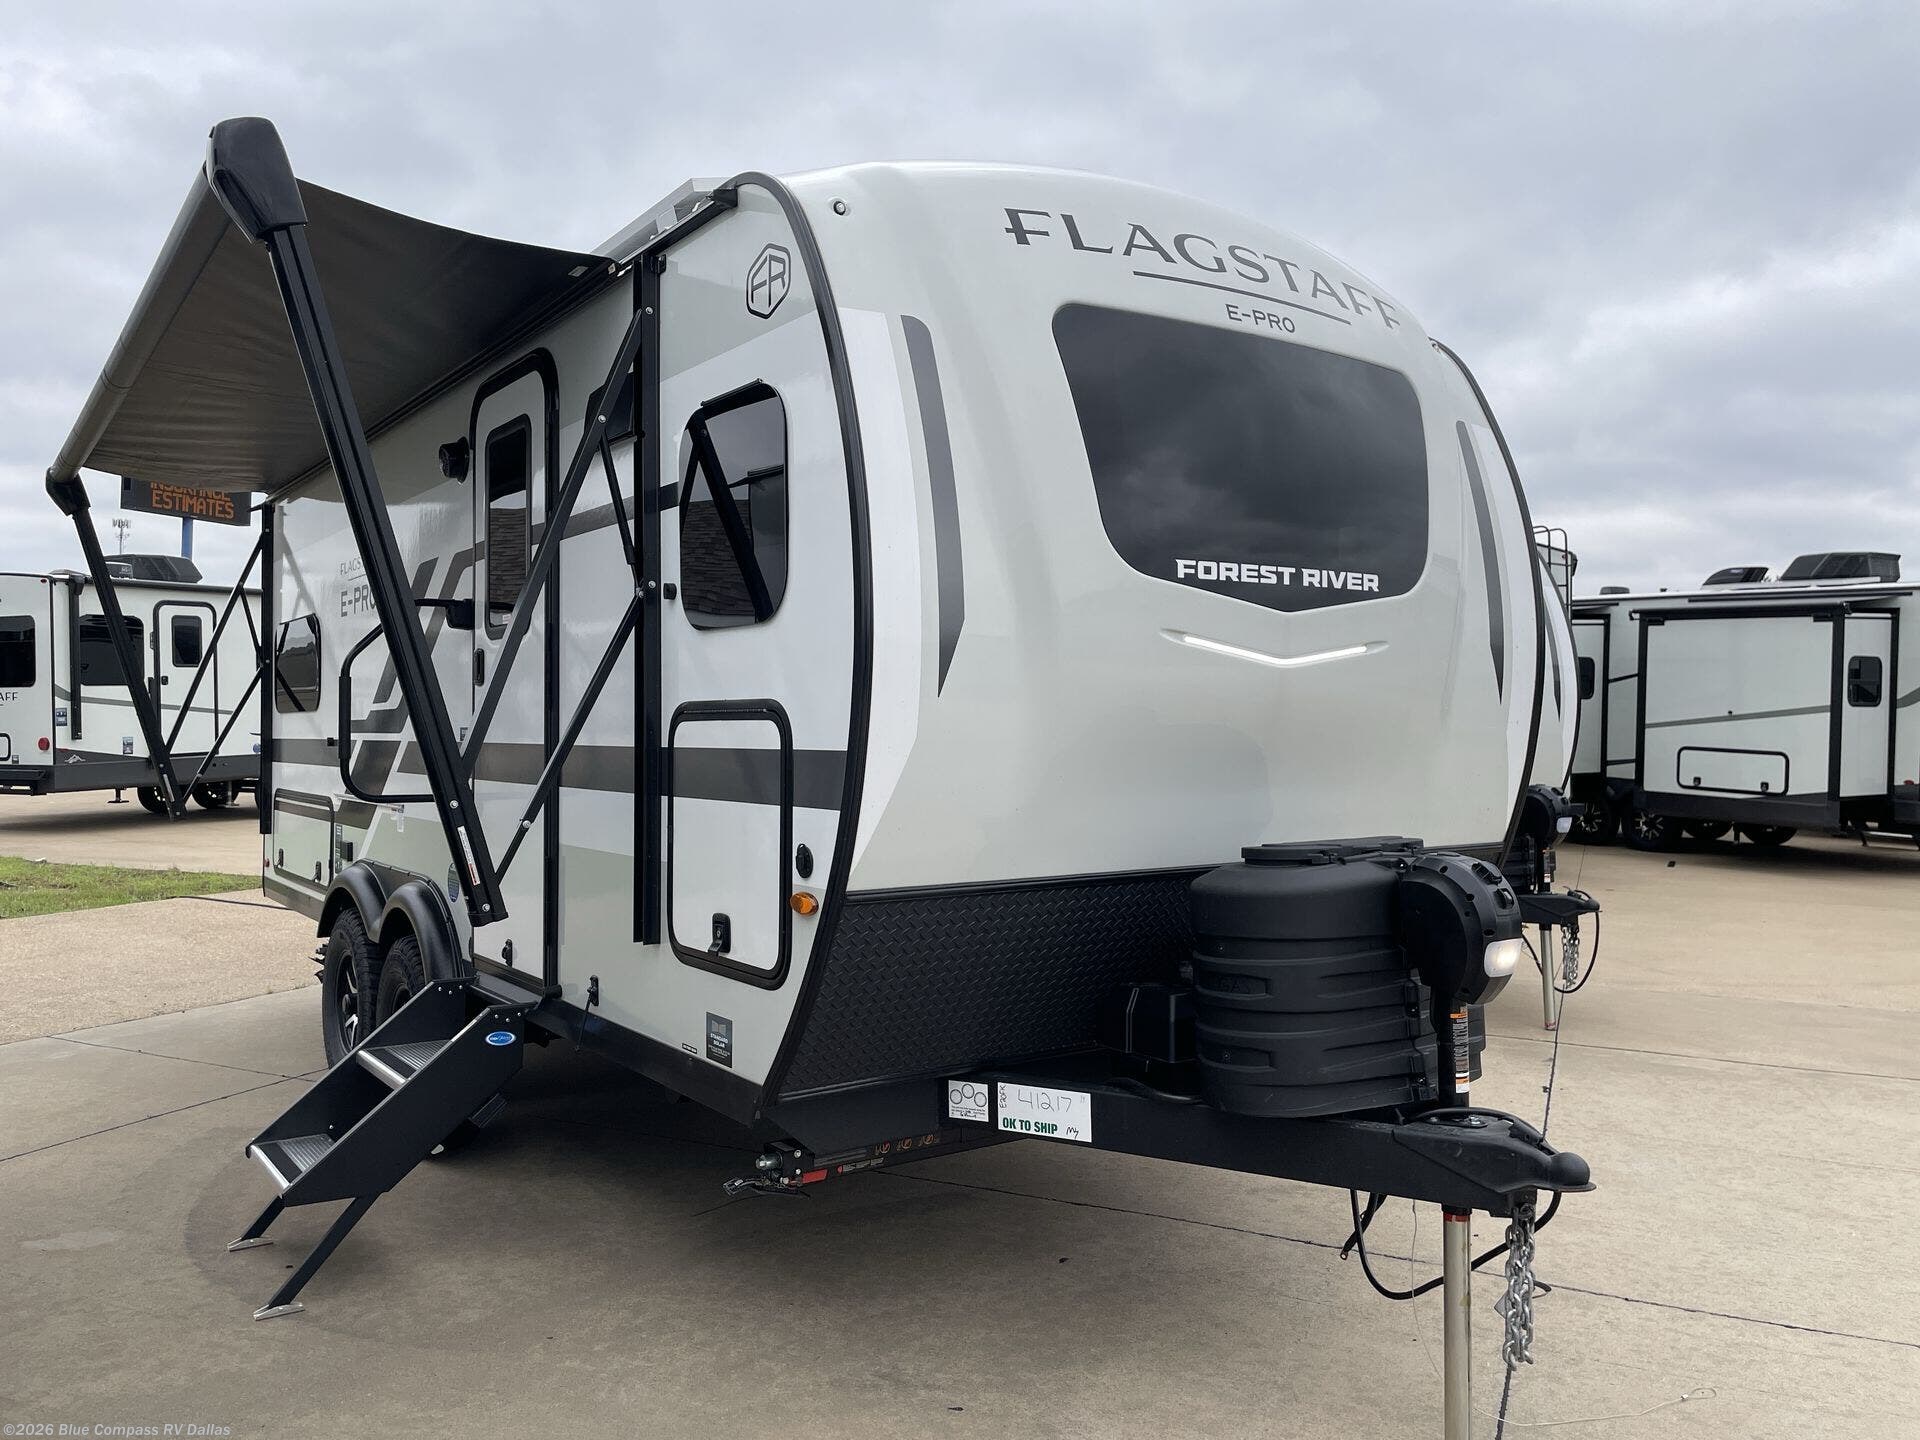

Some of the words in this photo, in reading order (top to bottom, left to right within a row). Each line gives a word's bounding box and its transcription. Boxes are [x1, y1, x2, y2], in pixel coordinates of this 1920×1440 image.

[1004, 207, 1400, 330] FLAGSTAFF
[1225, 303, 1296, 334] E-PRO
[151, 489, 235, 519] ESTIMATES
[1175, 558, 1296, 586] FOREST
[1301, 568, 1380, 592] RIVER
[1002, 1117, 1016, 1130] OK
[1019, 1119, 1031, 1132] TO
[1034, 1121, 1058, 1135] SHIP
